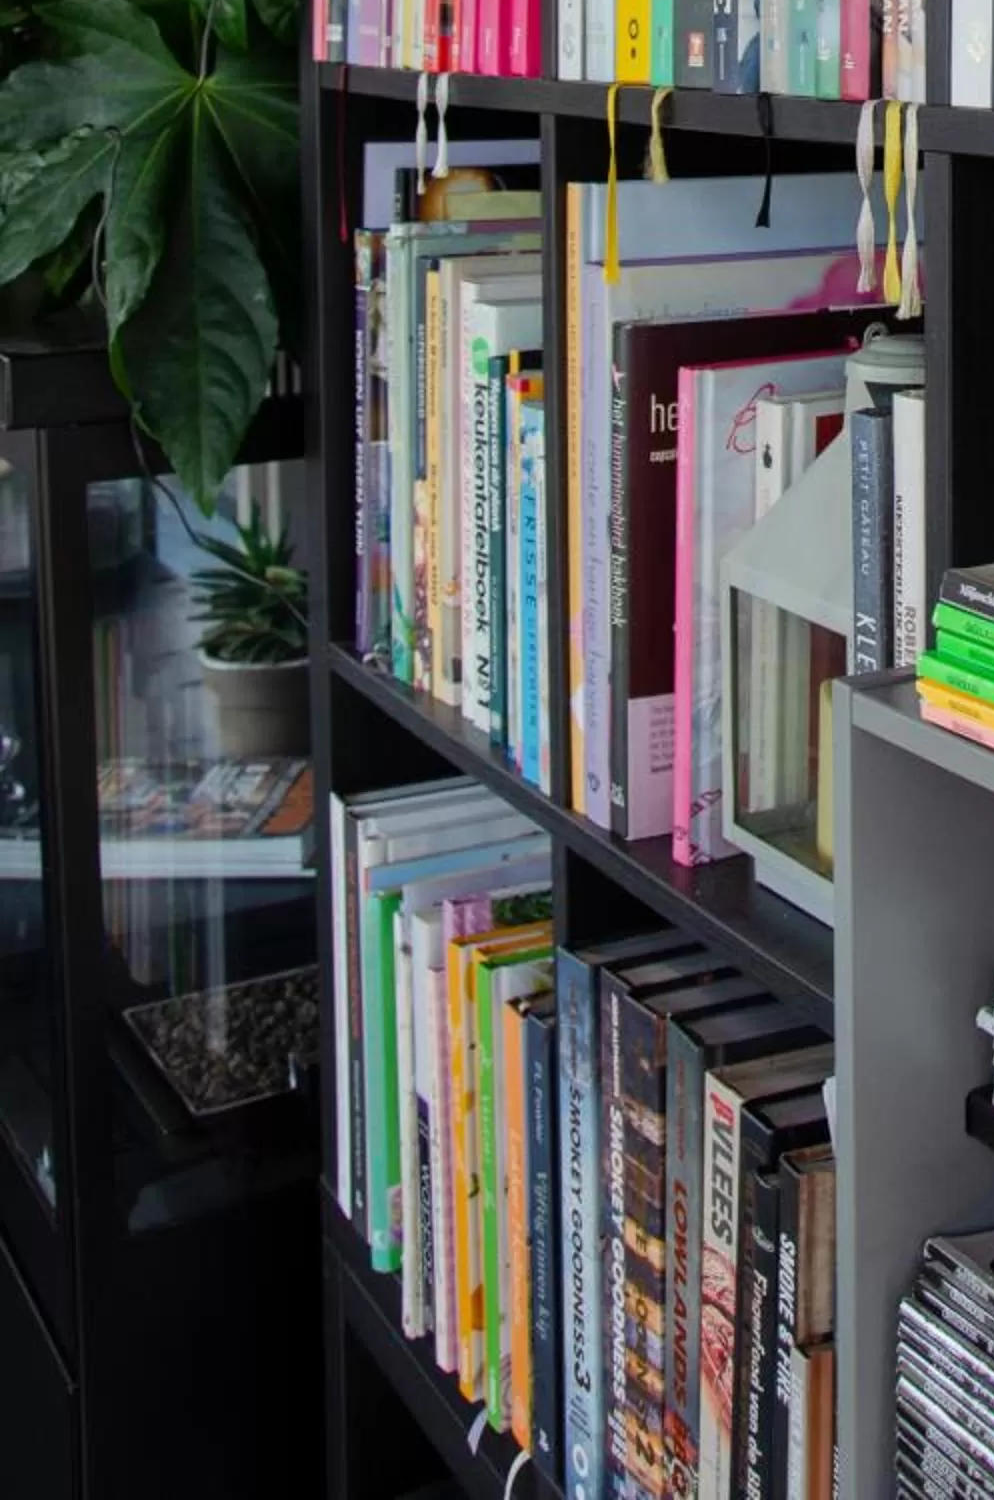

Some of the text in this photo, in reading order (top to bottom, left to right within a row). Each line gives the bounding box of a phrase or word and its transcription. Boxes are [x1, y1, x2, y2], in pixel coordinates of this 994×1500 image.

[474, 382, 490, 635] keukentafelboek
[607, 433, 627, 549] hummingbird
[523, 494, 537, 610] FRISSE
[608, 555, 627, 627] bakboek
[567, 1084, 584, 1197] SMOKEY
[609, 1104, 625, 1225] SMOKEY
[710, 1118, 733, 1246] VLEES
[532, 1170, 550, 1234] Vijftig
[534, 1304, 552, 1340] kip
[569, 1209, 586, 1360] GOODNESS
[610, 1236, 628, 1402] GOODNESS
[672, 1178, 689, 1409] LOWLANDS
[747, 1267, 768, 1388] Fingerfood
[778, 1232, 796, 1320] SMOKE
[778, 1323, 795, 1345] &
[747, 1391, 760, 1432] van
[747, 1438, 763, 1466] de
